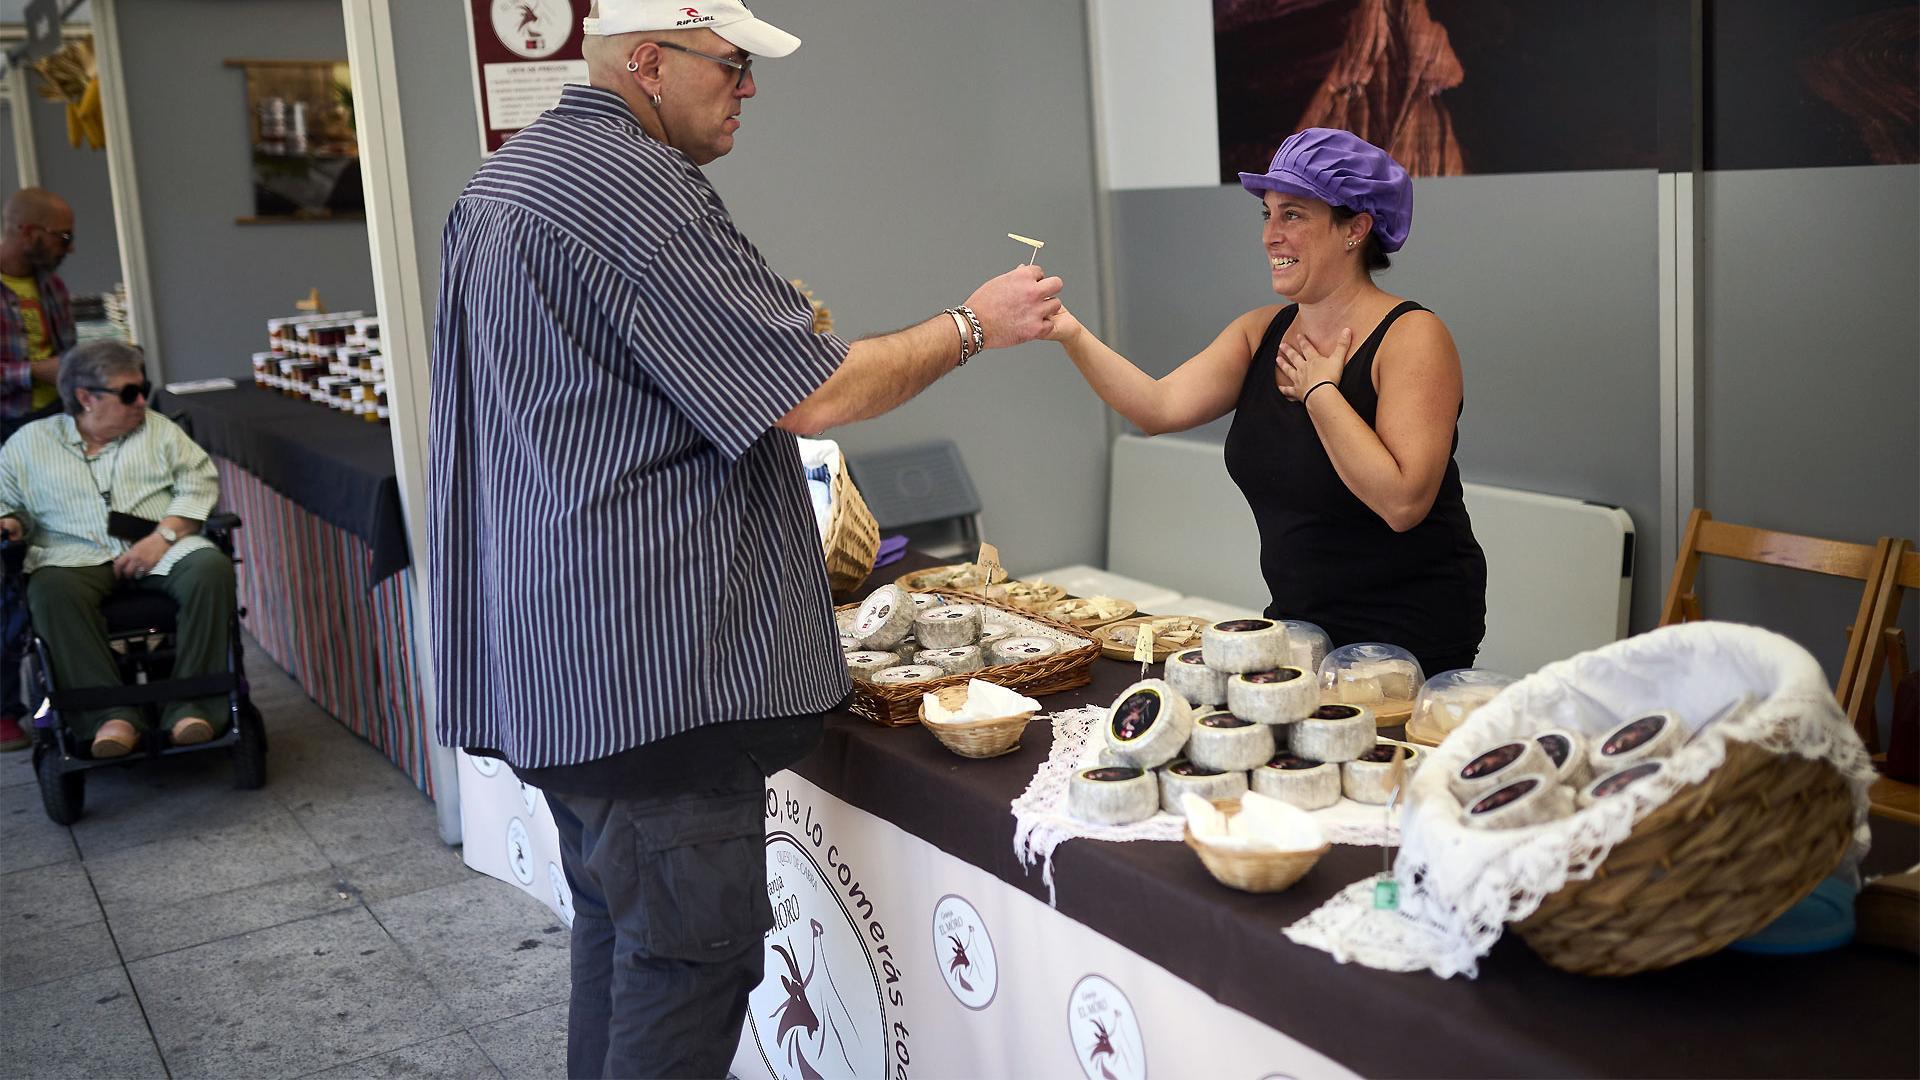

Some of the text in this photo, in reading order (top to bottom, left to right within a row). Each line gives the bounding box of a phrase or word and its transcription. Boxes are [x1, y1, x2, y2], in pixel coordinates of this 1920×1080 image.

[692, 15, 716, 24] CURL
[767, 871, 785, 899] anja
[785, 789, 800, 825] te
[805, 805, 823, 848] lo
[827, 845, 904, 1007] comerás
